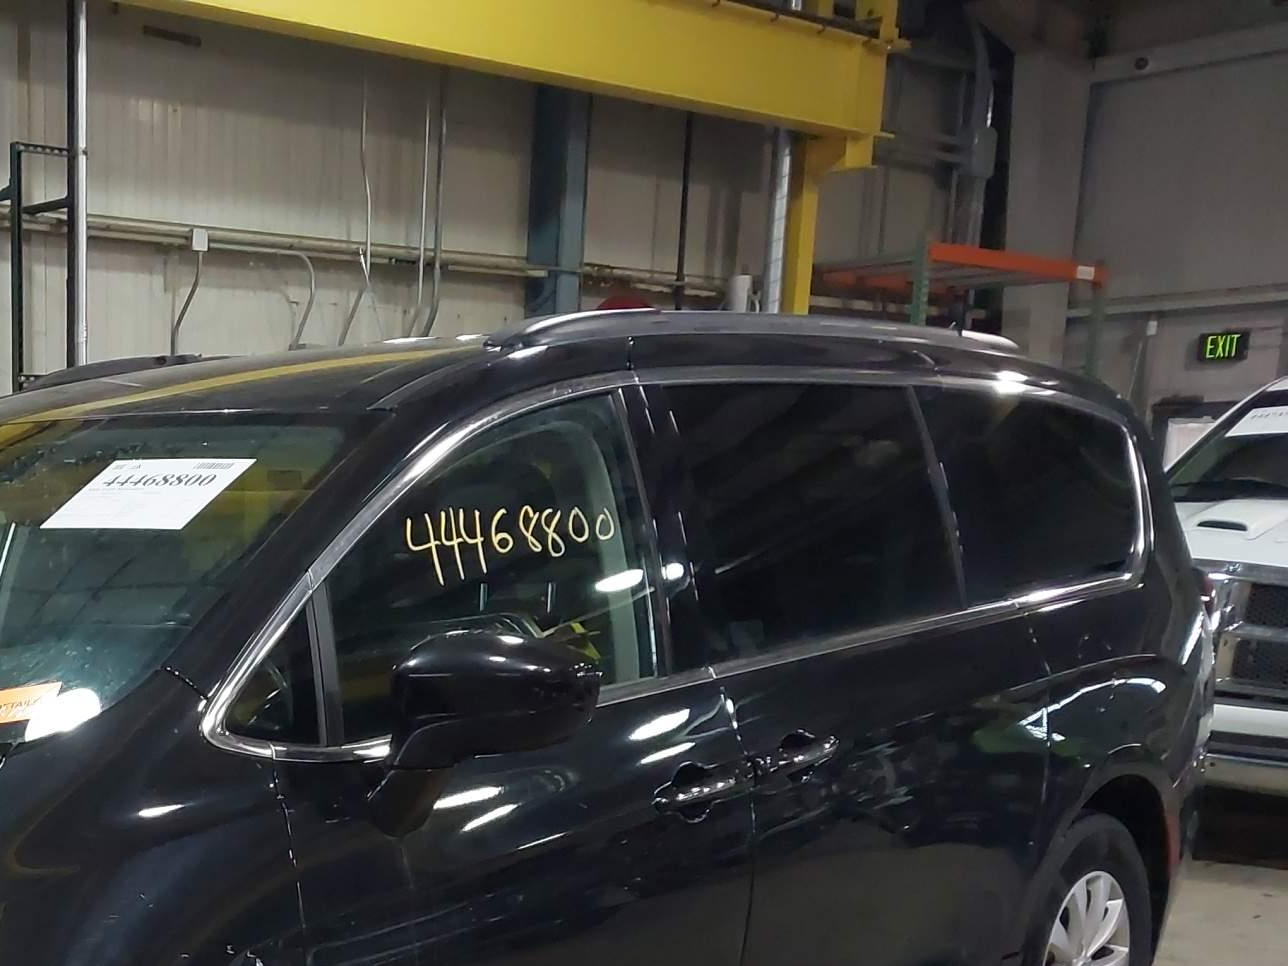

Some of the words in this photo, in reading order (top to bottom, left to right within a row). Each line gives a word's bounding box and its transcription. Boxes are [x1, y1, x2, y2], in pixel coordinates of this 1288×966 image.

[1205, 334, 1241, 359] EXIT
[103, 473, 217, 487] 44468800
[406, 505, 615, 586] 44468800
